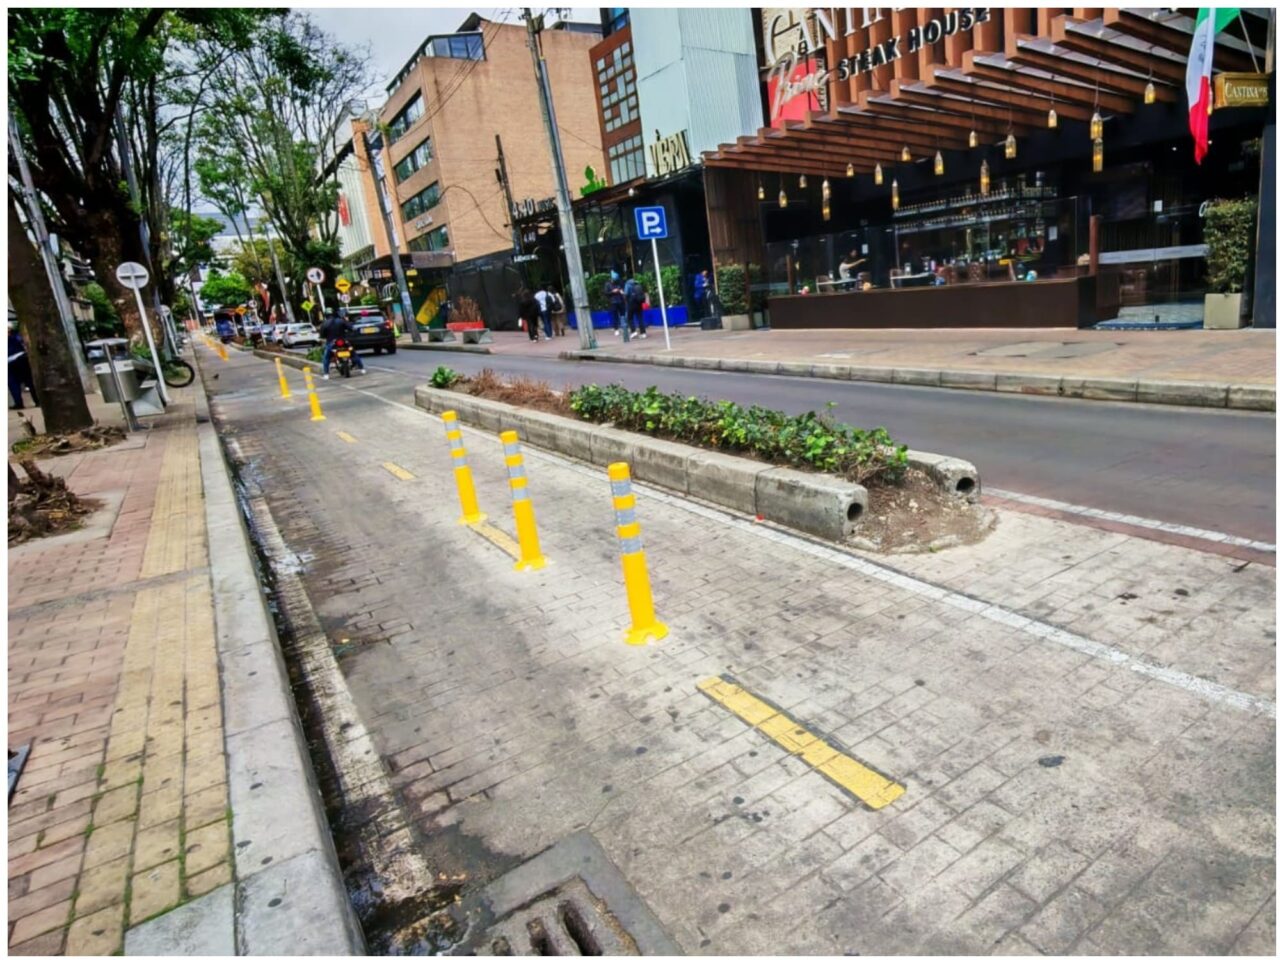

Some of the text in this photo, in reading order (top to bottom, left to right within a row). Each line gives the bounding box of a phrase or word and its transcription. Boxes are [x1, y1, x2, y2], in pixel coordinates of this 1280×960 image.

[838, 8, 990, 82] STEAK HOUSE
[641, 210, 660, 235] P
